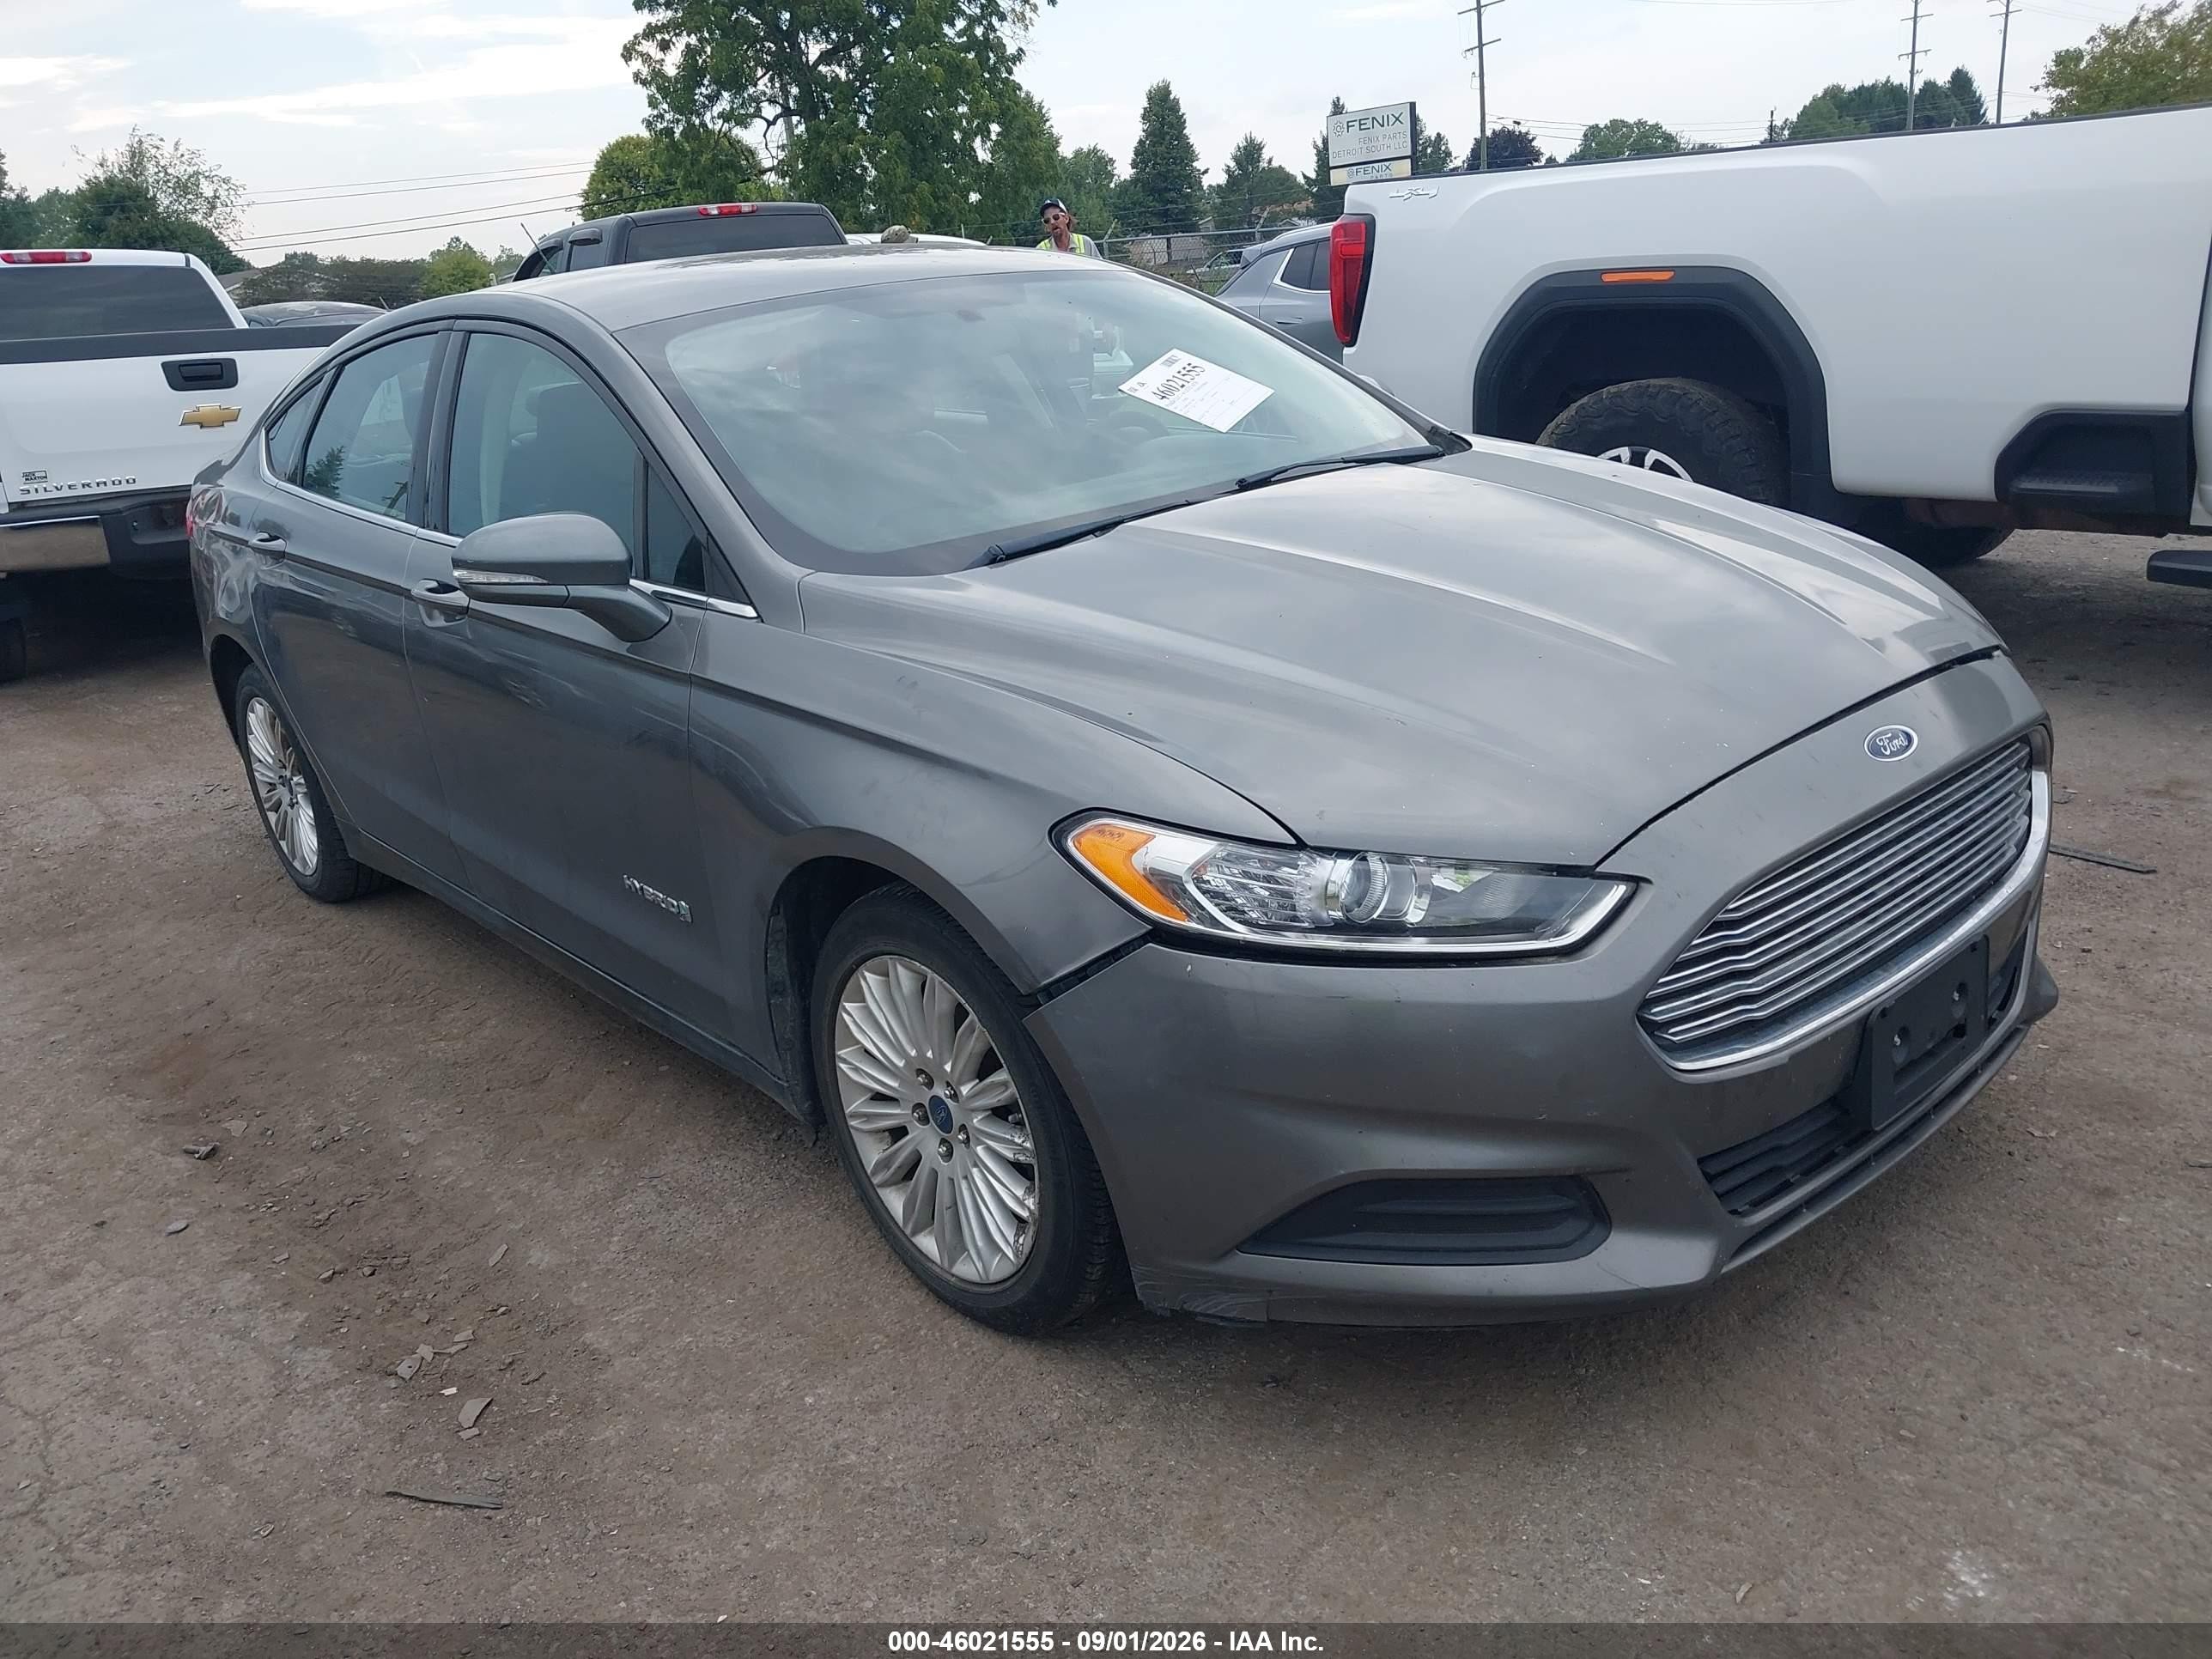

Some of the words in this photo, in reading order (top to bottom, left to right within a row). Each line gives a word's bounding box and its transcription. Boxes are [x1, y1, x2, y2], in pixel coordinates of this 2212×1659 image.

[1346, 112, 1404, 133] FENIX
[1358, 137, 1380, 145] FENIX
[1382, 131, 1407, 141] PARTS
[1332, 147, 1364, 159] DETROIT
[1366, 143, 1391, 154] SOUTH
[1394, 141, 1407, 150] LLC
[1355, 162, 1392, 176] FENIX
[1151, 362, 1206, 401] 46021555
[19, 476, 137, 495] SILVERADO
[1875, 732, 1909, 756] Ford
[623, 874, 679, 915] HYBRID
